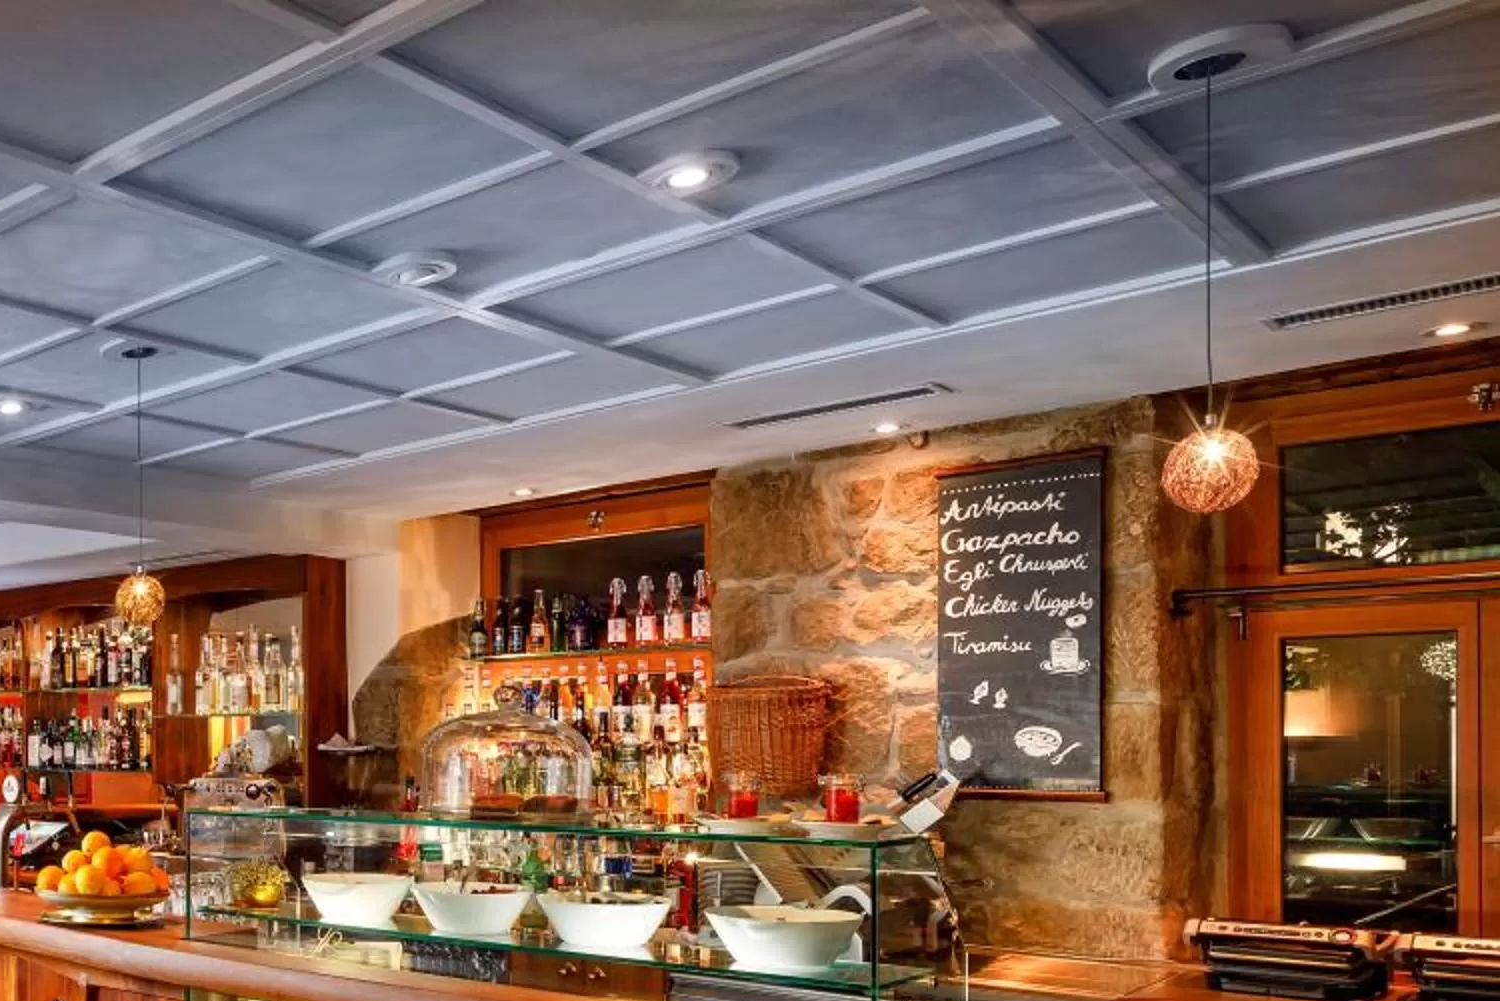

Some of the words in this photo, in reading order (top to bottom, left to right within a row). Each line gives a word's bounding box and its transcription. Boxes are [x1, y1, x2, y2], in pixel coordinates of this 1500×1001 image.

[940, 491, 1066, 524] Antipasti
[941, 521, 1081, 554] Gazpacho
[944, 560, 994, 591] Egli
[945, 593, 1019, 619] Chicken
[1024, 587, 1094, 616] Nuggets
[944, 629, 1032, 655] Tiramisu
